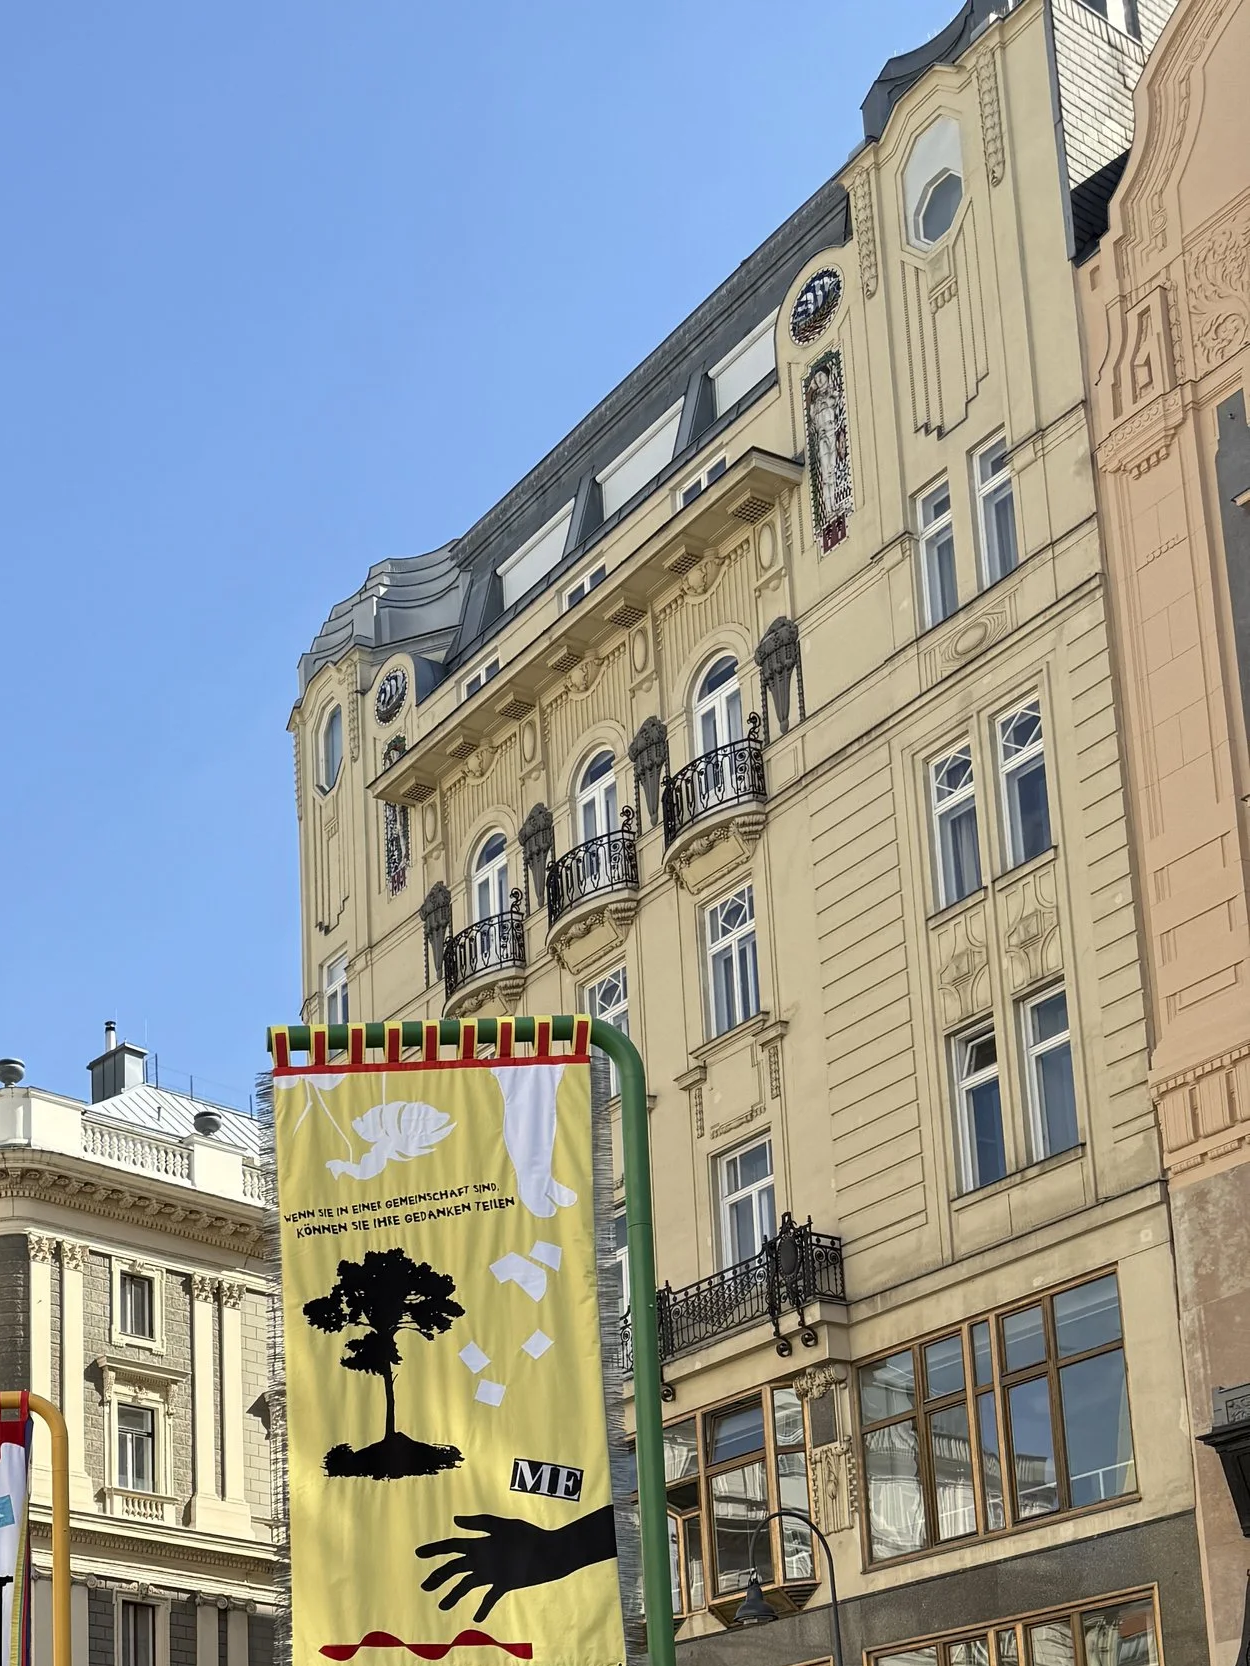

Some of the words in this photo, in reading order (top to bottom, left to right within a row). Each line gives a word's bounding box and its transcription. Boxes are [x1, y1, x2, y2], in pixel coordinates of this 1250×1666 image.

[283, 1208, 316, 1223] WENN
[318, 1207, 334, 1218] SIE
[336, 1205, 349, 1217] IN
[351, 1200, 382, 1214] EINER
[385, 1185, 470, 1209] GEMEINSCHAFT
[296, 1222, 348, 1239] KÖNNEN
[352, 1219, 370, 1231] SIE
[373, 1215, 400, 1229] IHRE
[404, 1202, 472, 1224] GEDANKEN
[474, 1196, 515, 1212] TEILEN
[511, 1459, 582, 1500] ME
